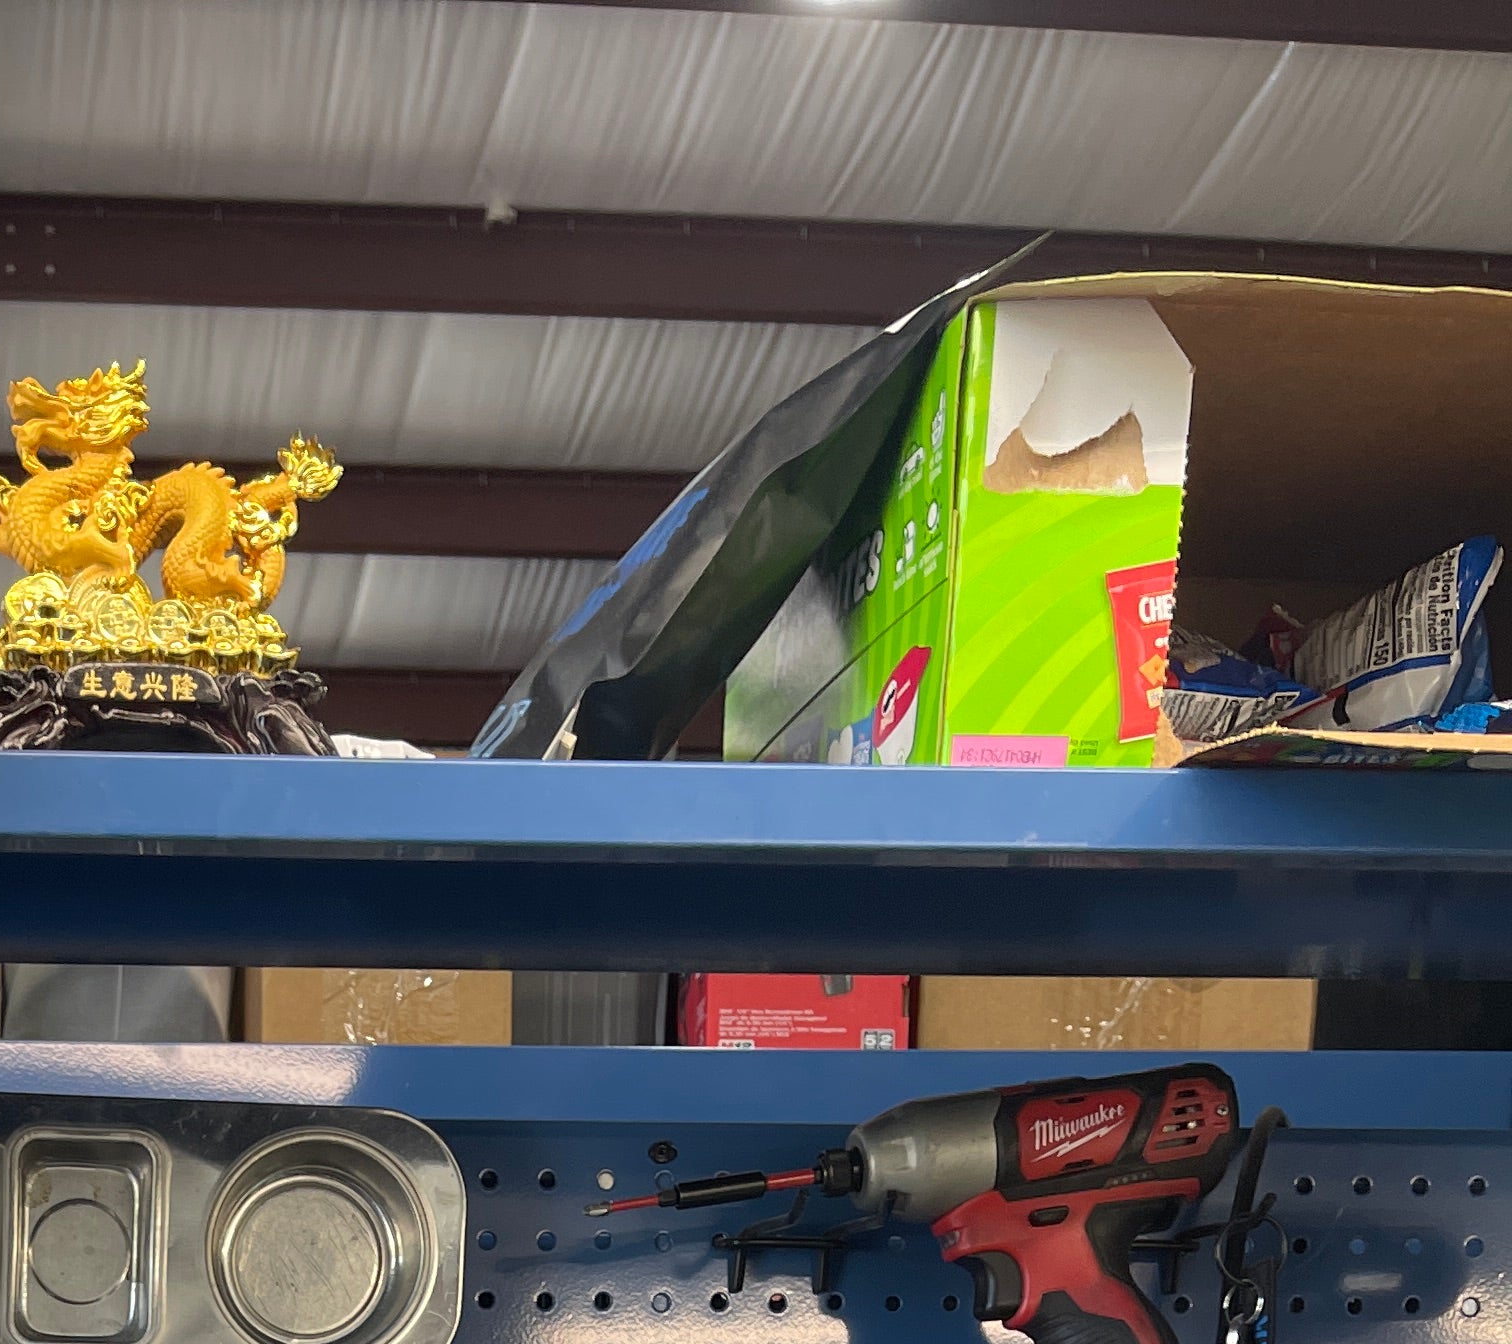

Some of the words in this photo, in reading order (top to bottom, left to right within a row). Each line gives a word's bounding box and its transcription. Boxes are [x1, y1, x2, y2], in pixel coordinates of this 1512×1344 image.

[1439, 607, 1455, 652] Facts
[1372, 641, 1390, 666] 150
[79, 669, 198, 701] 生意兴隆
[1029, 1104, 1126, 1151] Milwaukee
